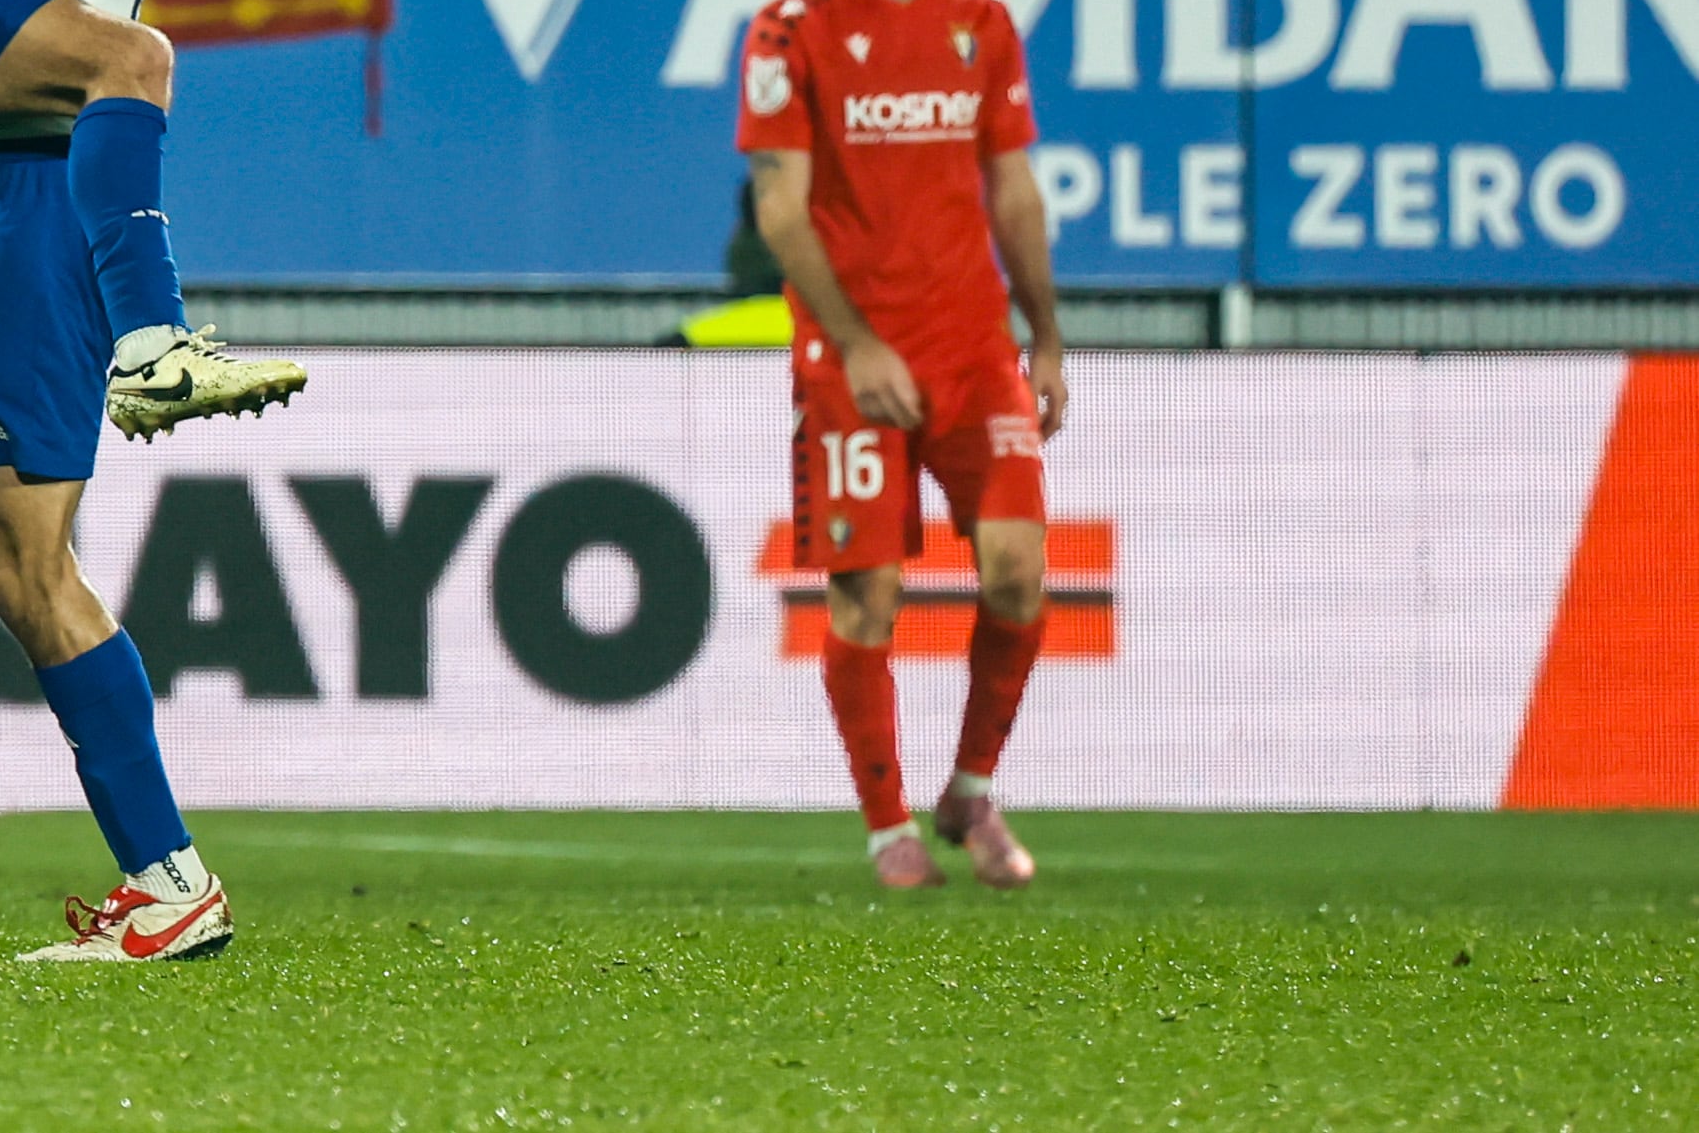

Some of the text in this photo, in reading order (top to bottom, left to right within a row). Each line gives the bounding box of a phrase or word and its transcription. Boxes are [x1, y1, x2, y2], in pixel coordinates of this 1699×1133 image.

[1034, 143, 1626, 249] PLE ZERO
[821, 429, 885, 501] 16
